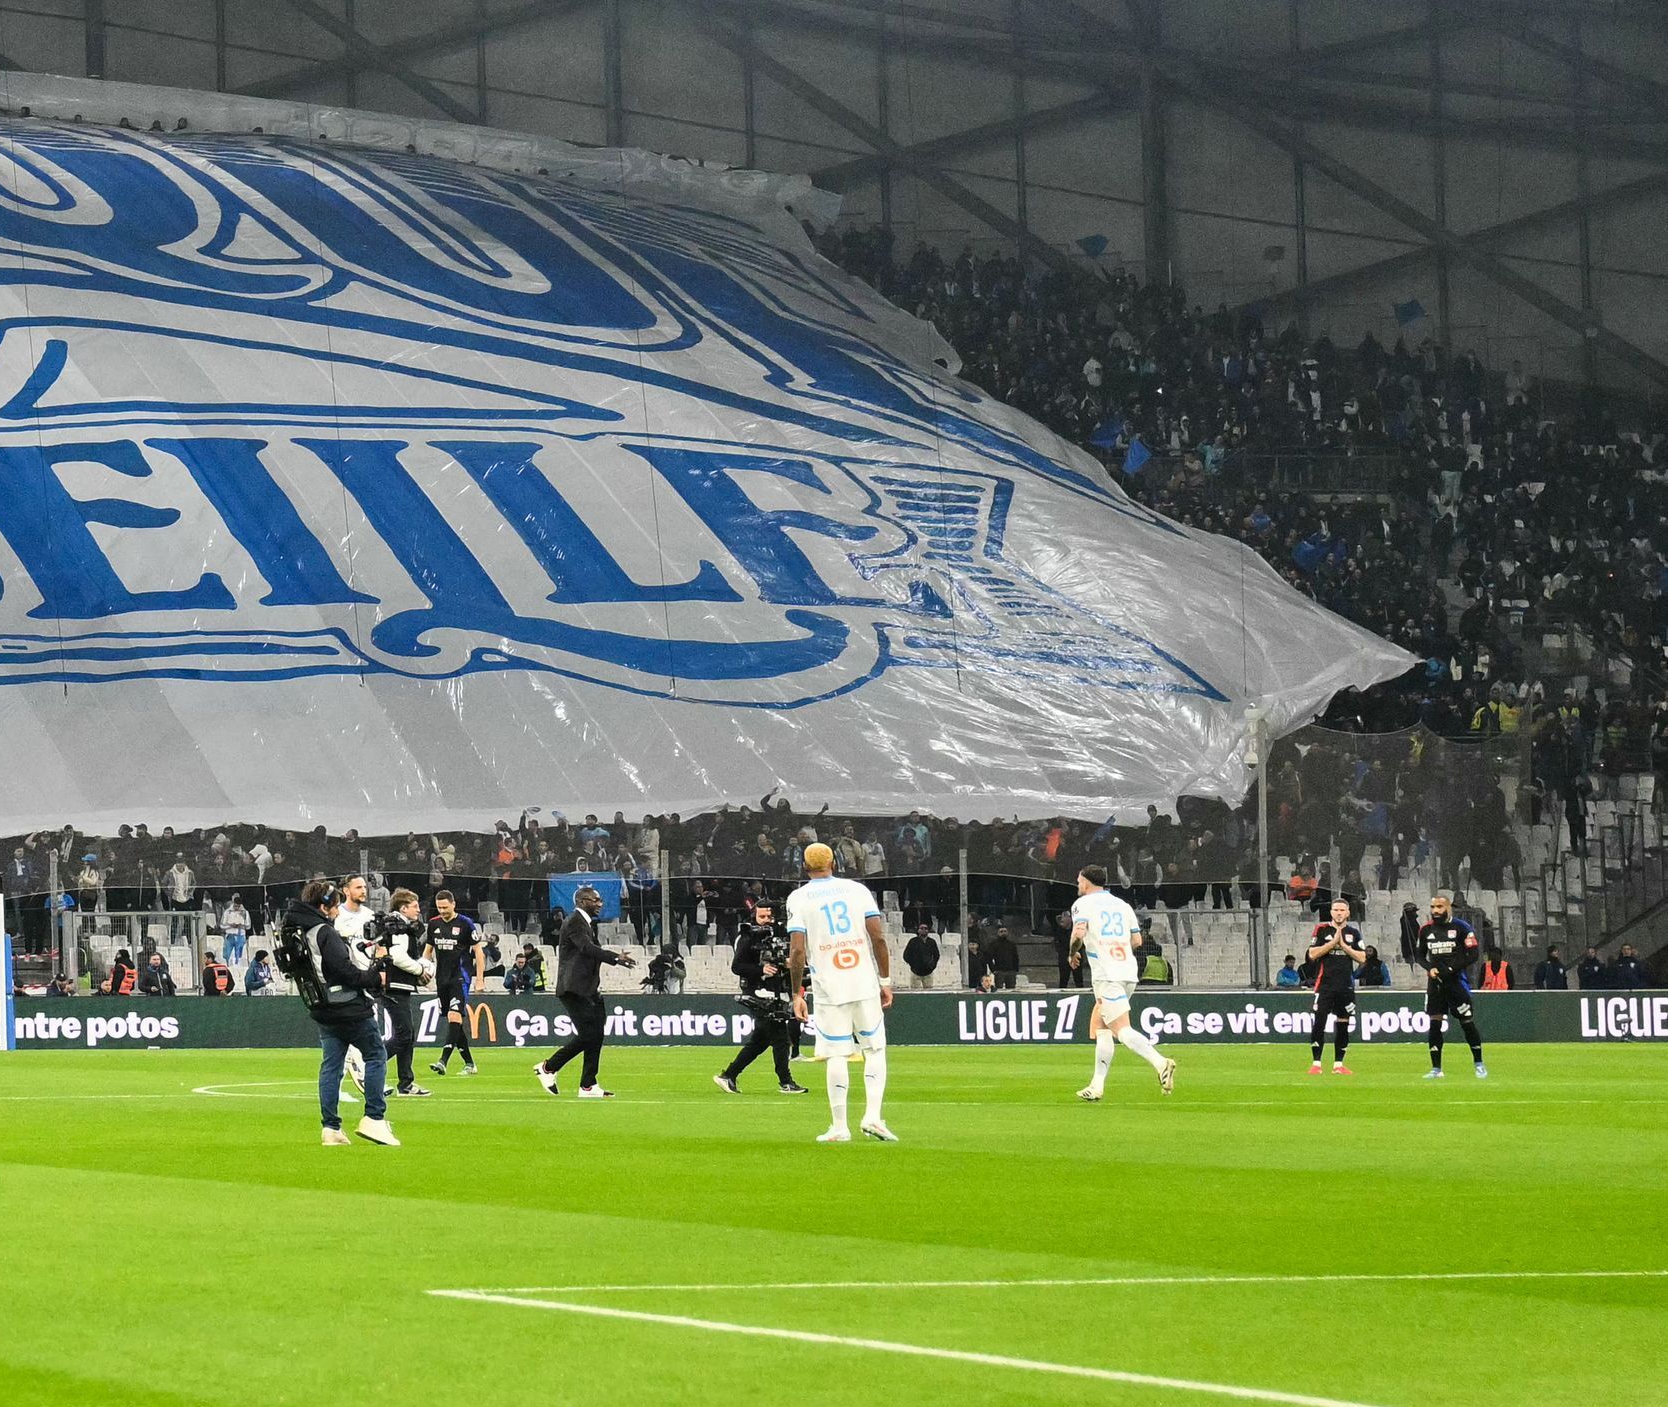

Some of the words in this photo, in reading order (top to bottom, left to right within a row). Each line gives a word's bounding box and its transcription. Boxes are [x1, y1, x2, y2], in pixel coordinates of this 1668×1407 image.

[820, 900, 852, 935] 13
[1100, 911, 1124, 937] 23
[3, 1011, 81, 1039] ntre
[86, 1011, 179, 1046] potos
[506, 1008, 548, 1047] Ça
[642, 1009, 727, 1037] entre
[959, 999, 1049, 1041] LIGUE
[1140, 1006, 1182, 1043] Ça
[1186, 1012, 1223, 1034] se
[1228, 1003, 1270, 1034] vit
[1581, 996, 1668, 1038] LIGUE
